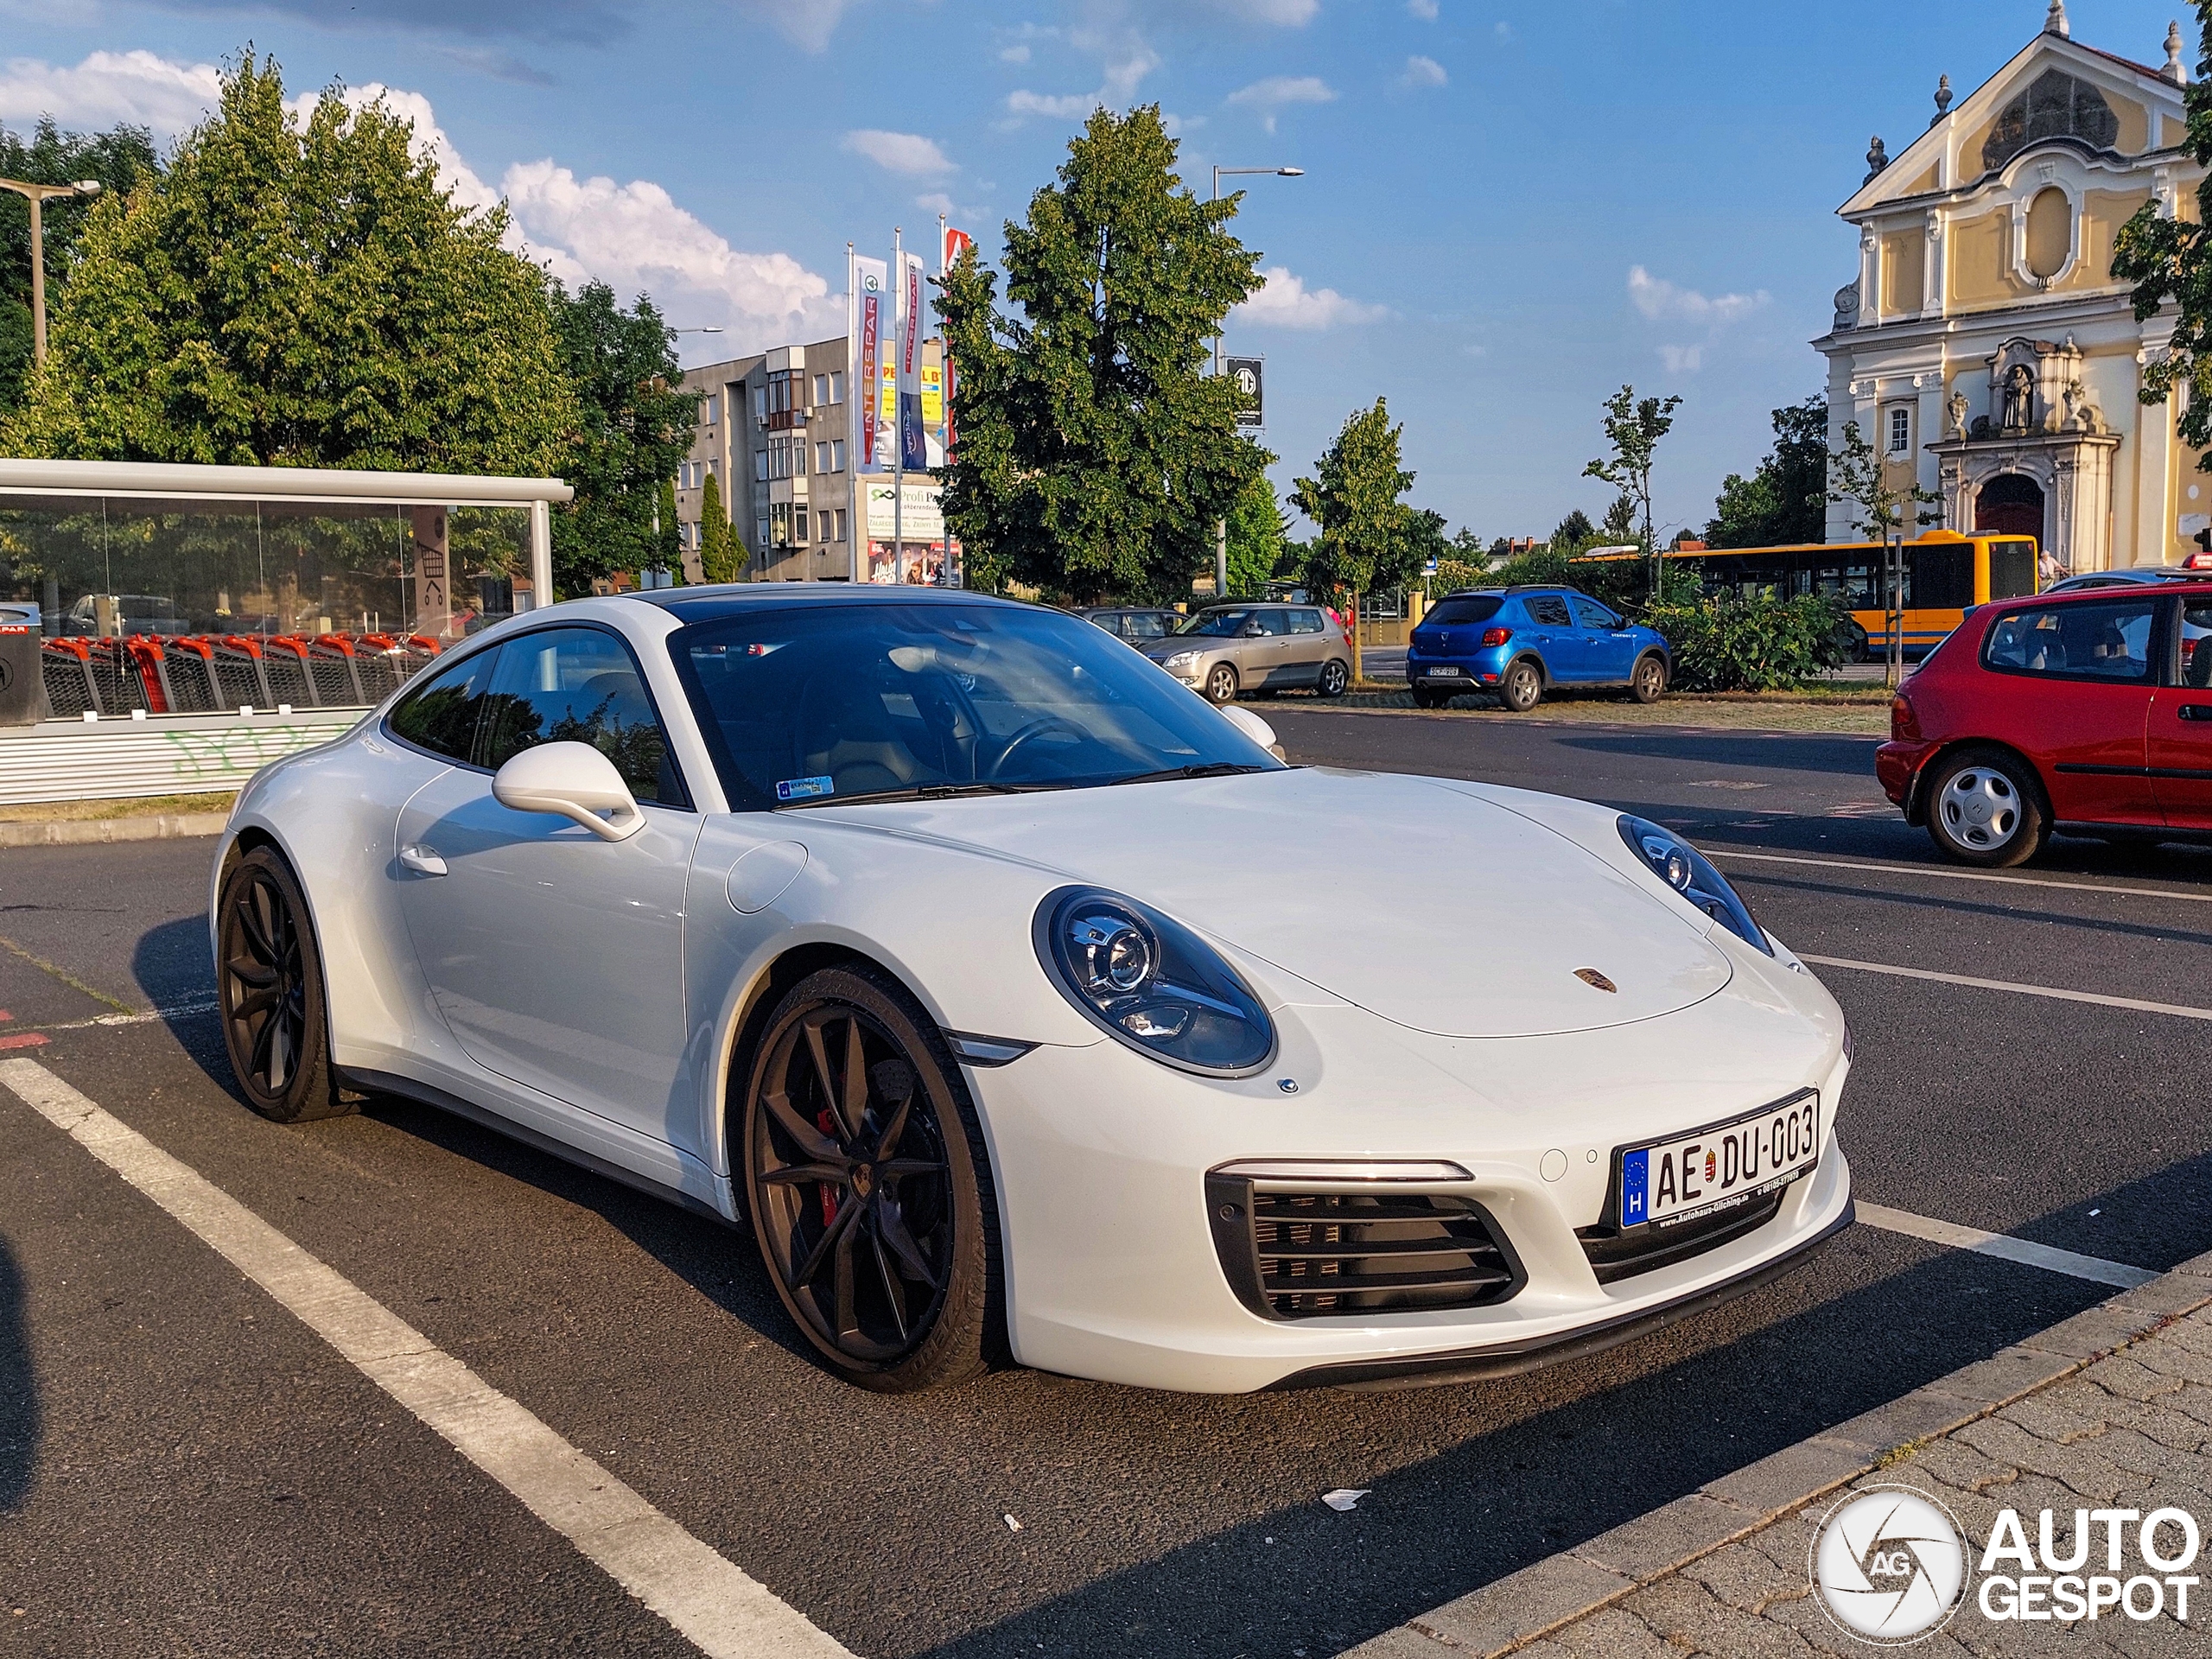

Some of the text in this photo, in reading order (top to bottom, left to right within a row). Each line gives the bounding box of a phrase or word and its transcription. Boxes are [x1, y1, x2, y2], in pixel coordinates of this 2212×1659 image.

[906, 274, 917, 365] INTERSPAR
[865, 297, 876, 432] INTERSPAR
[1630, 1192, 1642, 1214] H
[1656, 1145, 1701, 1209] AE
